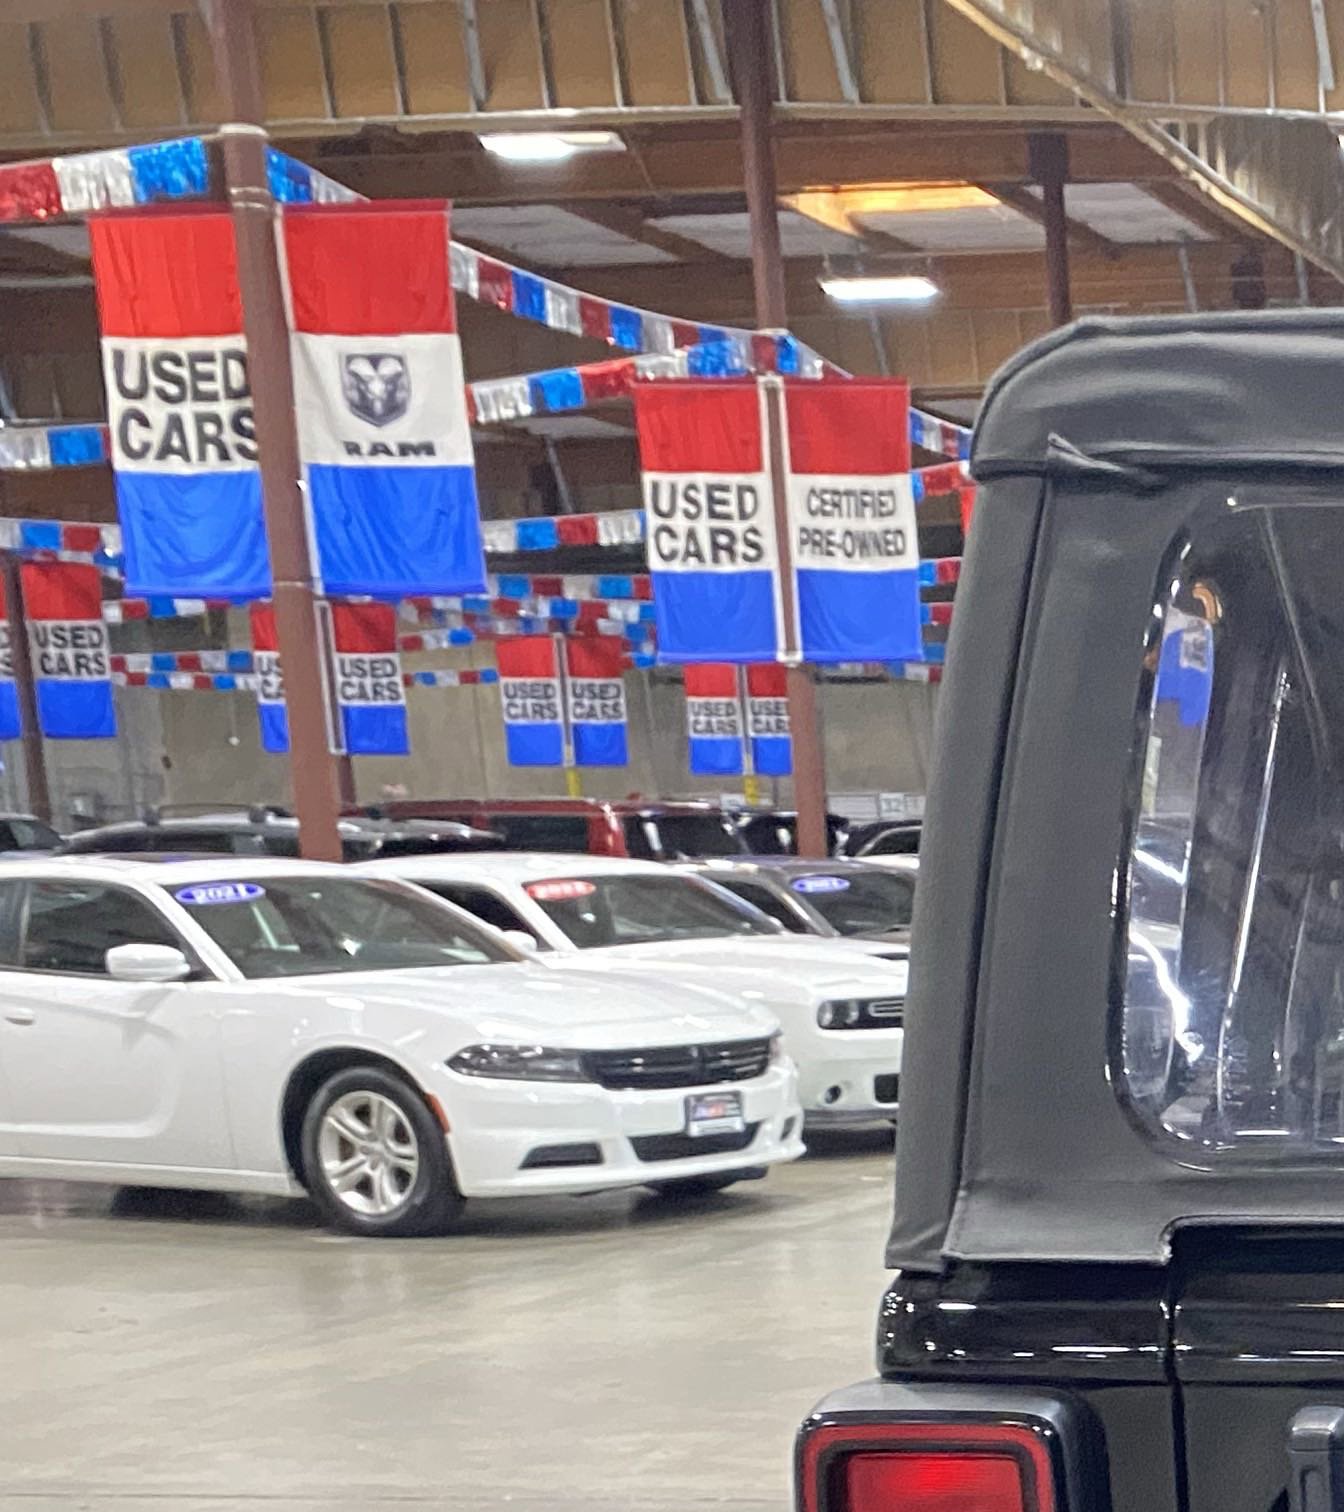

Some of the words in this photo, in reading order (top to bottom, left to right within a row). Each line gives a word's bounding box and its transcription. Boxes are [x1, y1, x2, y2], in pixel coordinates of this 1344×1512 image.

[112, 348, 249, 405] USED
[118, 406, 260, 463] CARS
[341, 440, 437, 457] RAM
[651, 481, 759, 521] USED
[806, 487, 897, 518] CERTIFIED
[653, 523, 764, 564] CARS
[799, 526, 905, 558] PRE-OWNED
[34, 624, 104, 649] USED
[40, 652, 106, 676] CARS
[338, 657, 398, 679] USED
[340, 681, 401, 701] CARS
[503, 681, 557, 700] USED
[570, 682, 622, 700] USED
[505, 701, 559, 720] CARS
[572, 701, 623, 720] CARS
[690, 700, 737, 717] USED
[750, 700, 789, 717] USE
[752, 718, 789, 734] CAR
